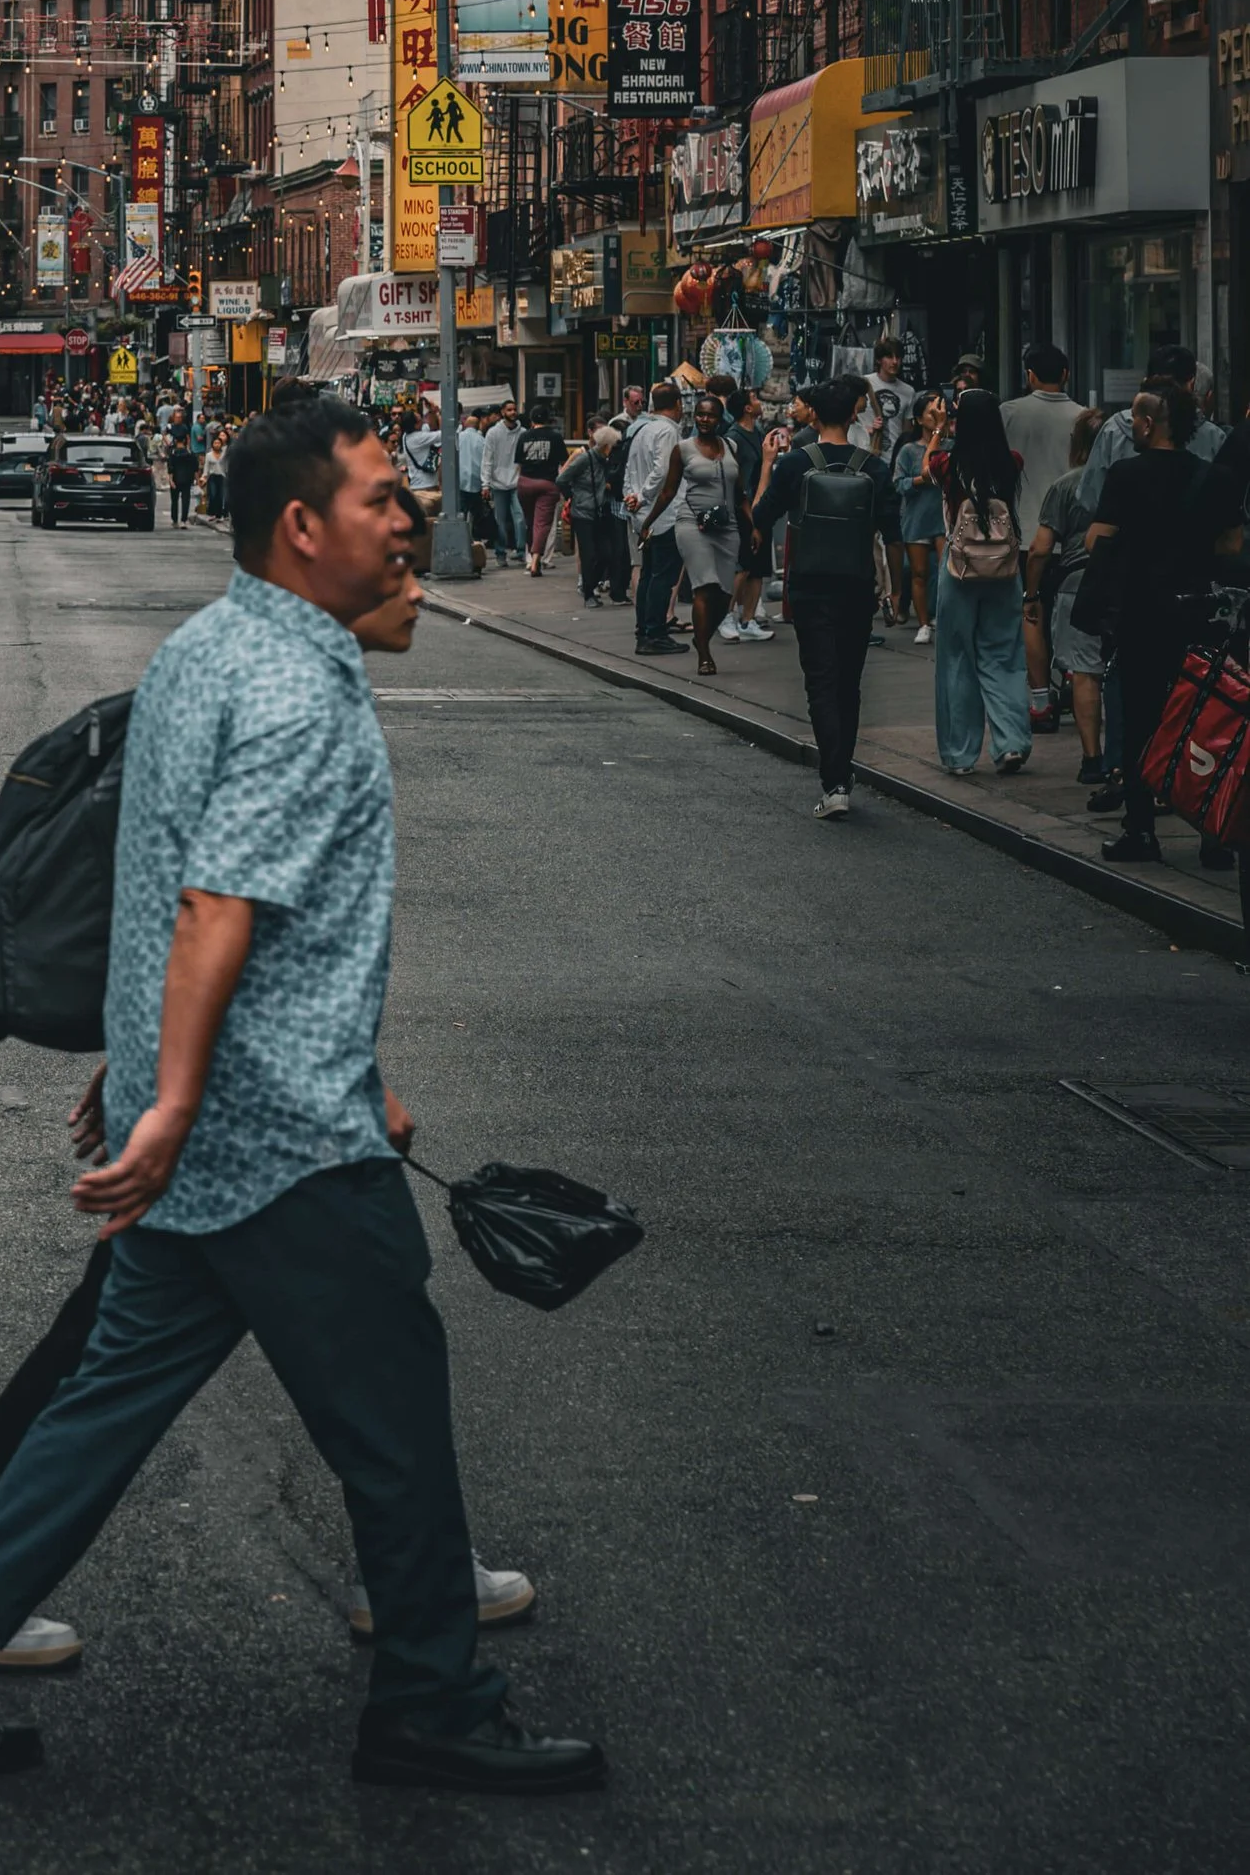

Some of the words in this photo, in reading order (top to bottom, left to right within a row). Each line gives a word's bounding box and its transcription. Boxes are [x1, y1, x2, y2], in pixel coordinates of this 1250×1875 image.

[623, 21, 686, 51] 餐館
[459, 62, 549, 74] WWW.CHINATOWN.NYC
[549, 52, 608, 81] ONG
[640, 59, 666, 71] NEW
[622, 75, 684, 87] SHANGHAI
[614, 92, 695, 104] RESTAURANT
[998, 104, 1046, 199] TESO
[414, 162, 479, 176] SCHOOL
[404, 200, 434, 214] MING
[400, 222, 437, 237] WONG
[379, 282, 414, 305] GIFT
[419, 281, 437, 304] SH
[219, 298, 240, 306] WINE
[384, 313, 390, 324] 4
[68, 336, 87, 345] STOP
